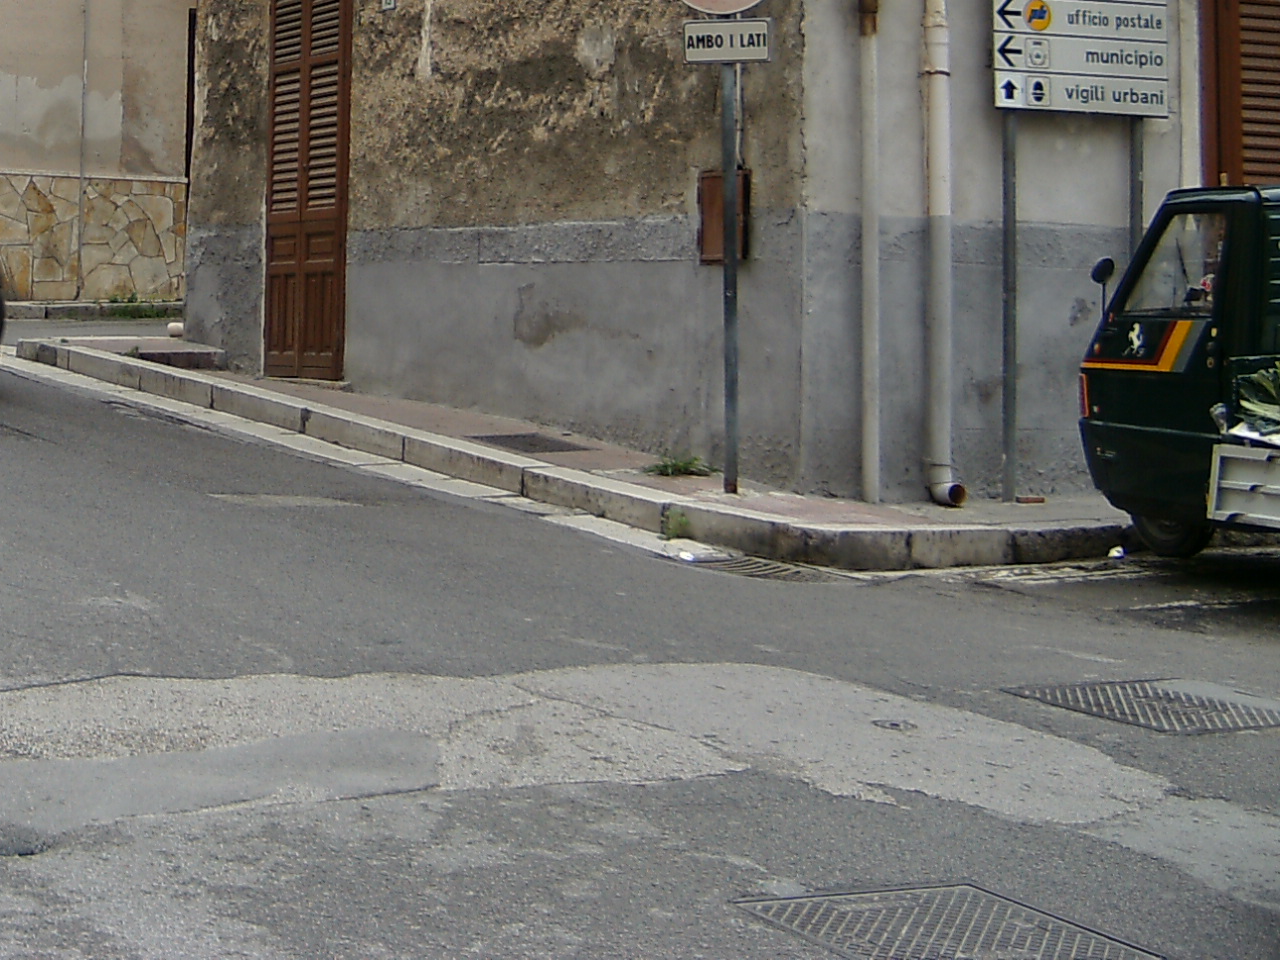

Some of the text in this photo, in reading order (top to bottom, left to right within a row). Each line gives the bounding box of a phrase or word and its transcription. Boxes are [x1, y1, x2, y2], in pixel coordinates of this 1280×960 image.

[1067, 9, 1162, 31] ufficio postale
[686, 32, 768, 50] AMBO I LATI
[1085, 50, 1164, 68] municipio
[1065, 84, 1164, 106] vigili urbani
